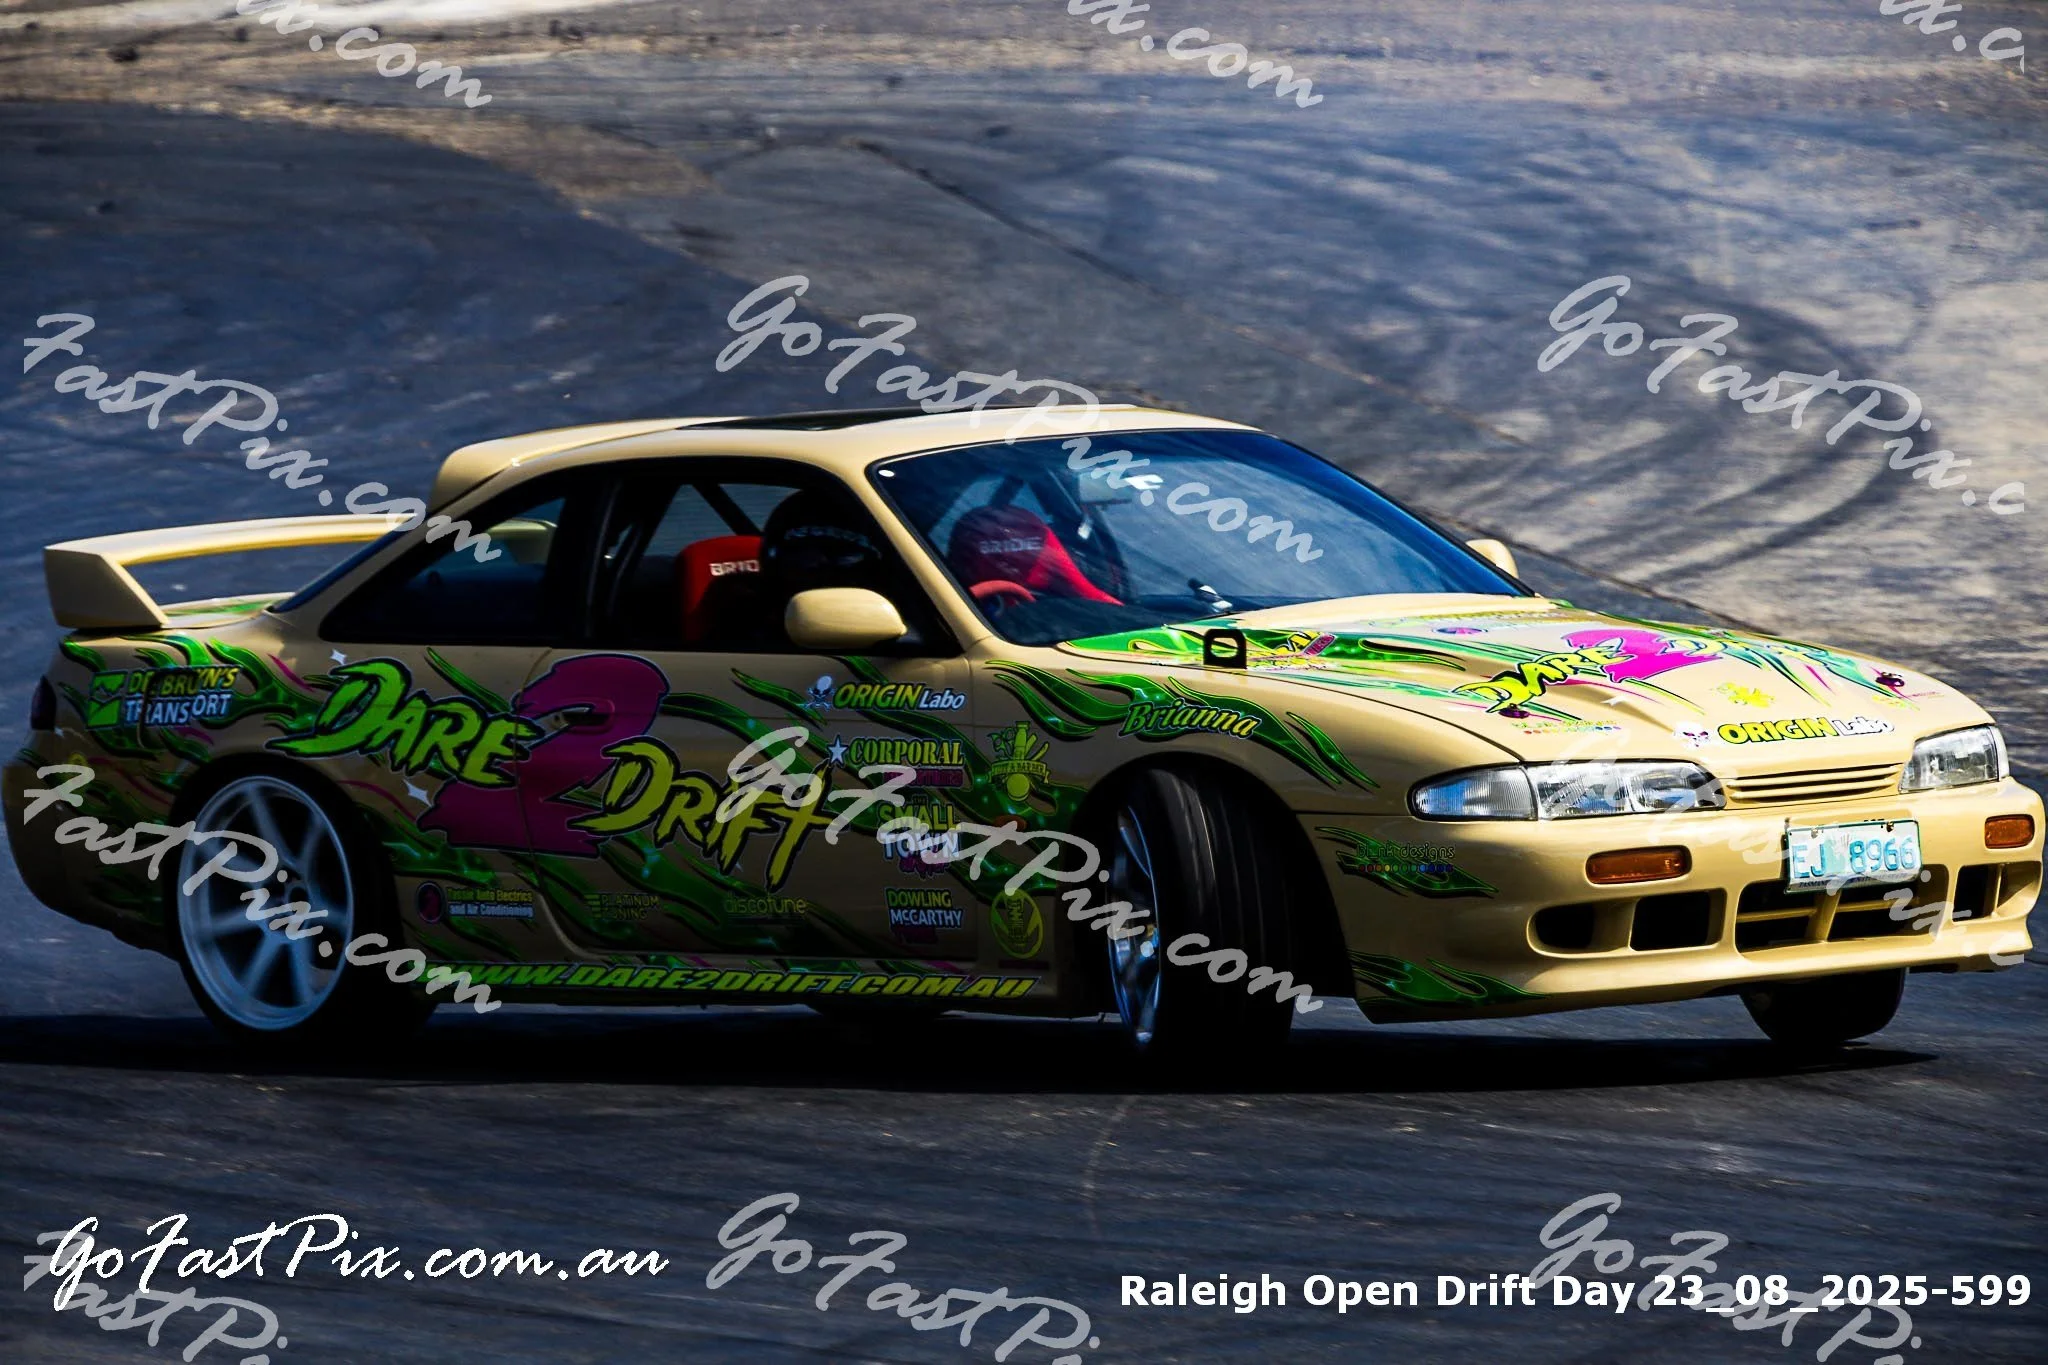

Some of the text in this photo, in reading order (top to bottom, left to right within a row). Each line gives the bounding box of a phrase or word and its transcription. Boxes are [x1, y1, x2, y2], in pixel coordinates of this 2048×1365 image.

[708, 559, 762, 577] BRID
[1451, 644, 1636, 714] DARE
[1558, 628, 1722, 684] 2
[125, 693, 232, 725] TRANSORT
[832, 682, 966, 711] ORIGIN Labo
[1119, 699, 1262, 740] Brianna
[1718, 715, 1896, 746] ORIGIN Labo
[849, 738, 965, 765] CORPORAL
[266, 653, 843, 892] DARE 2 DRIFT
[878, 803, 959, 832] SMALL
[1400, 841, 1455, 862] designs
[1792, 843, 1828, 878] EJ
[1849, 837, 1916, 874] 8966
[886, 888, 953, 908] DOWLING
